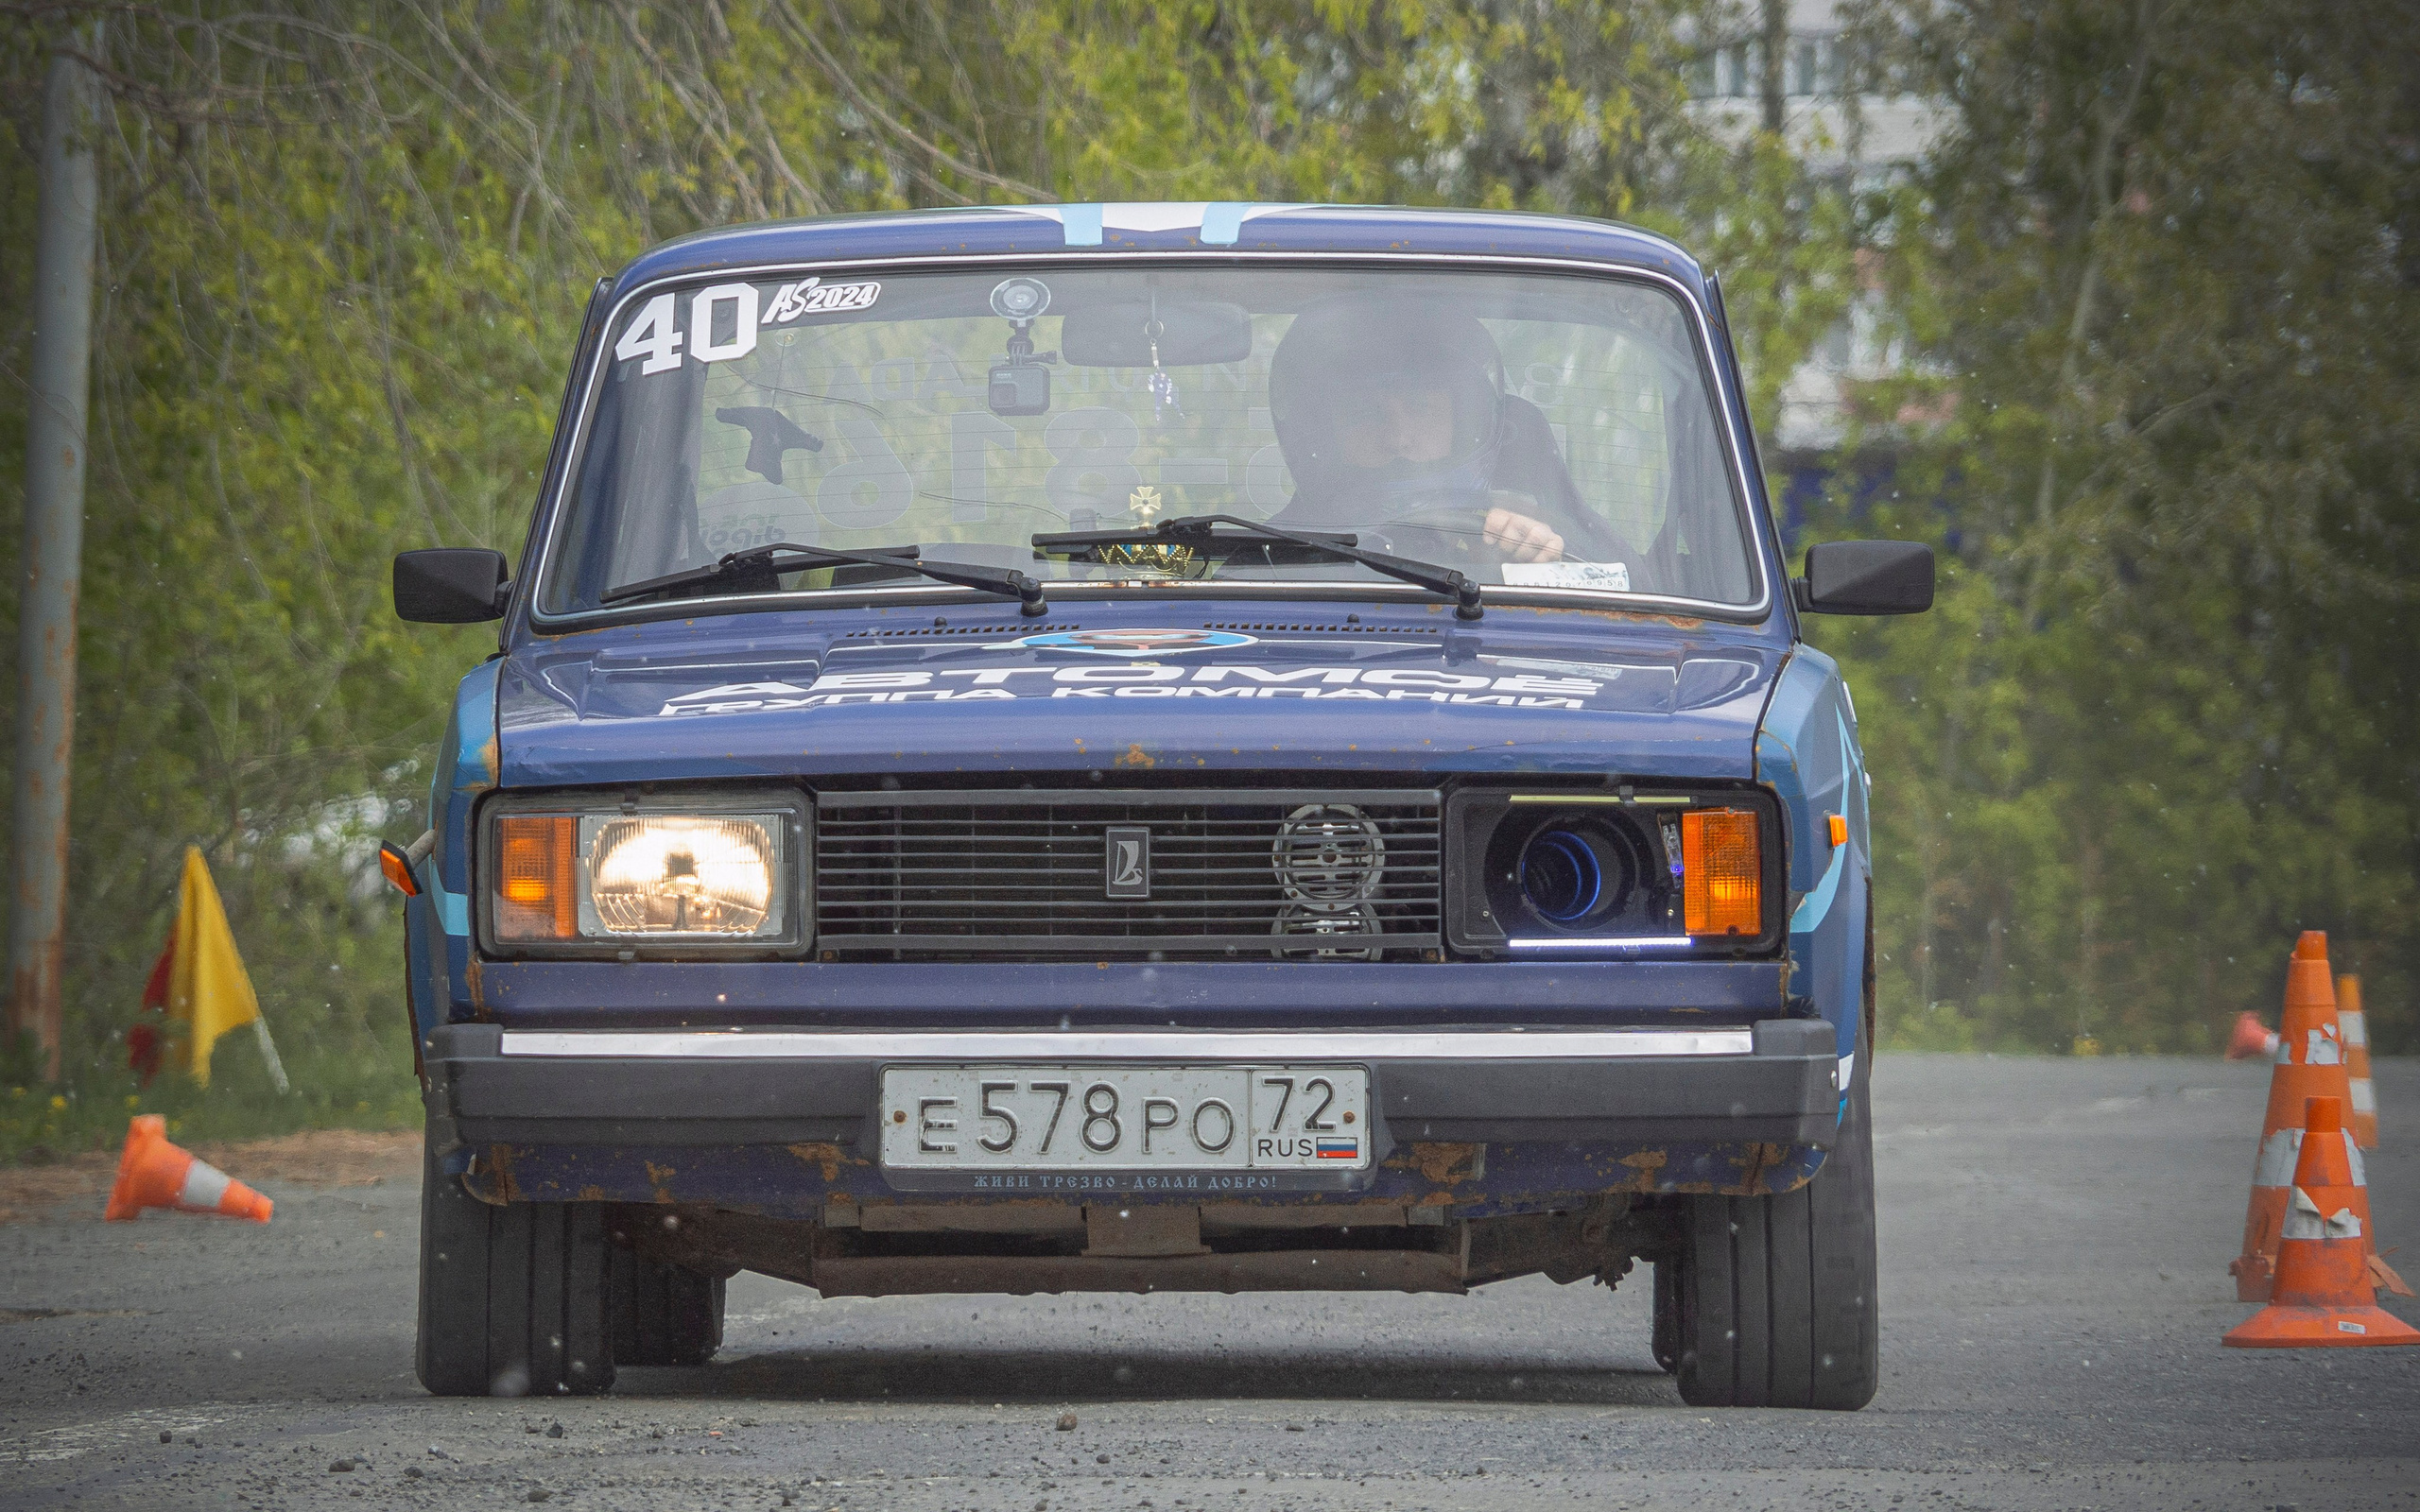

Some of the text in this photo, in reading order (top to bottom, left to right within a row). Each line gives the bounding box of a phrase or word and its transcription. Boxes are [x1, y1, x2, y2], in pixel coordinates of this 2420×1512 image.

[614, 283, 759, 375] 40
[659, 686, 1583, 715] ГРУППА КОМПАНИИ
[1262, 1075, 1336, 1131] 72
[1257, 1139, 1313, 1158] RUS
[975, 1176, 1029, 1189] ЖИВИ
[1040, 1176, 1116, 1189] ТРЕЗВО
[1133, 1175, 1200, 1190] ДЕЛАЙ
[1208, 1176, 1278, 1190] ДОБРО!
